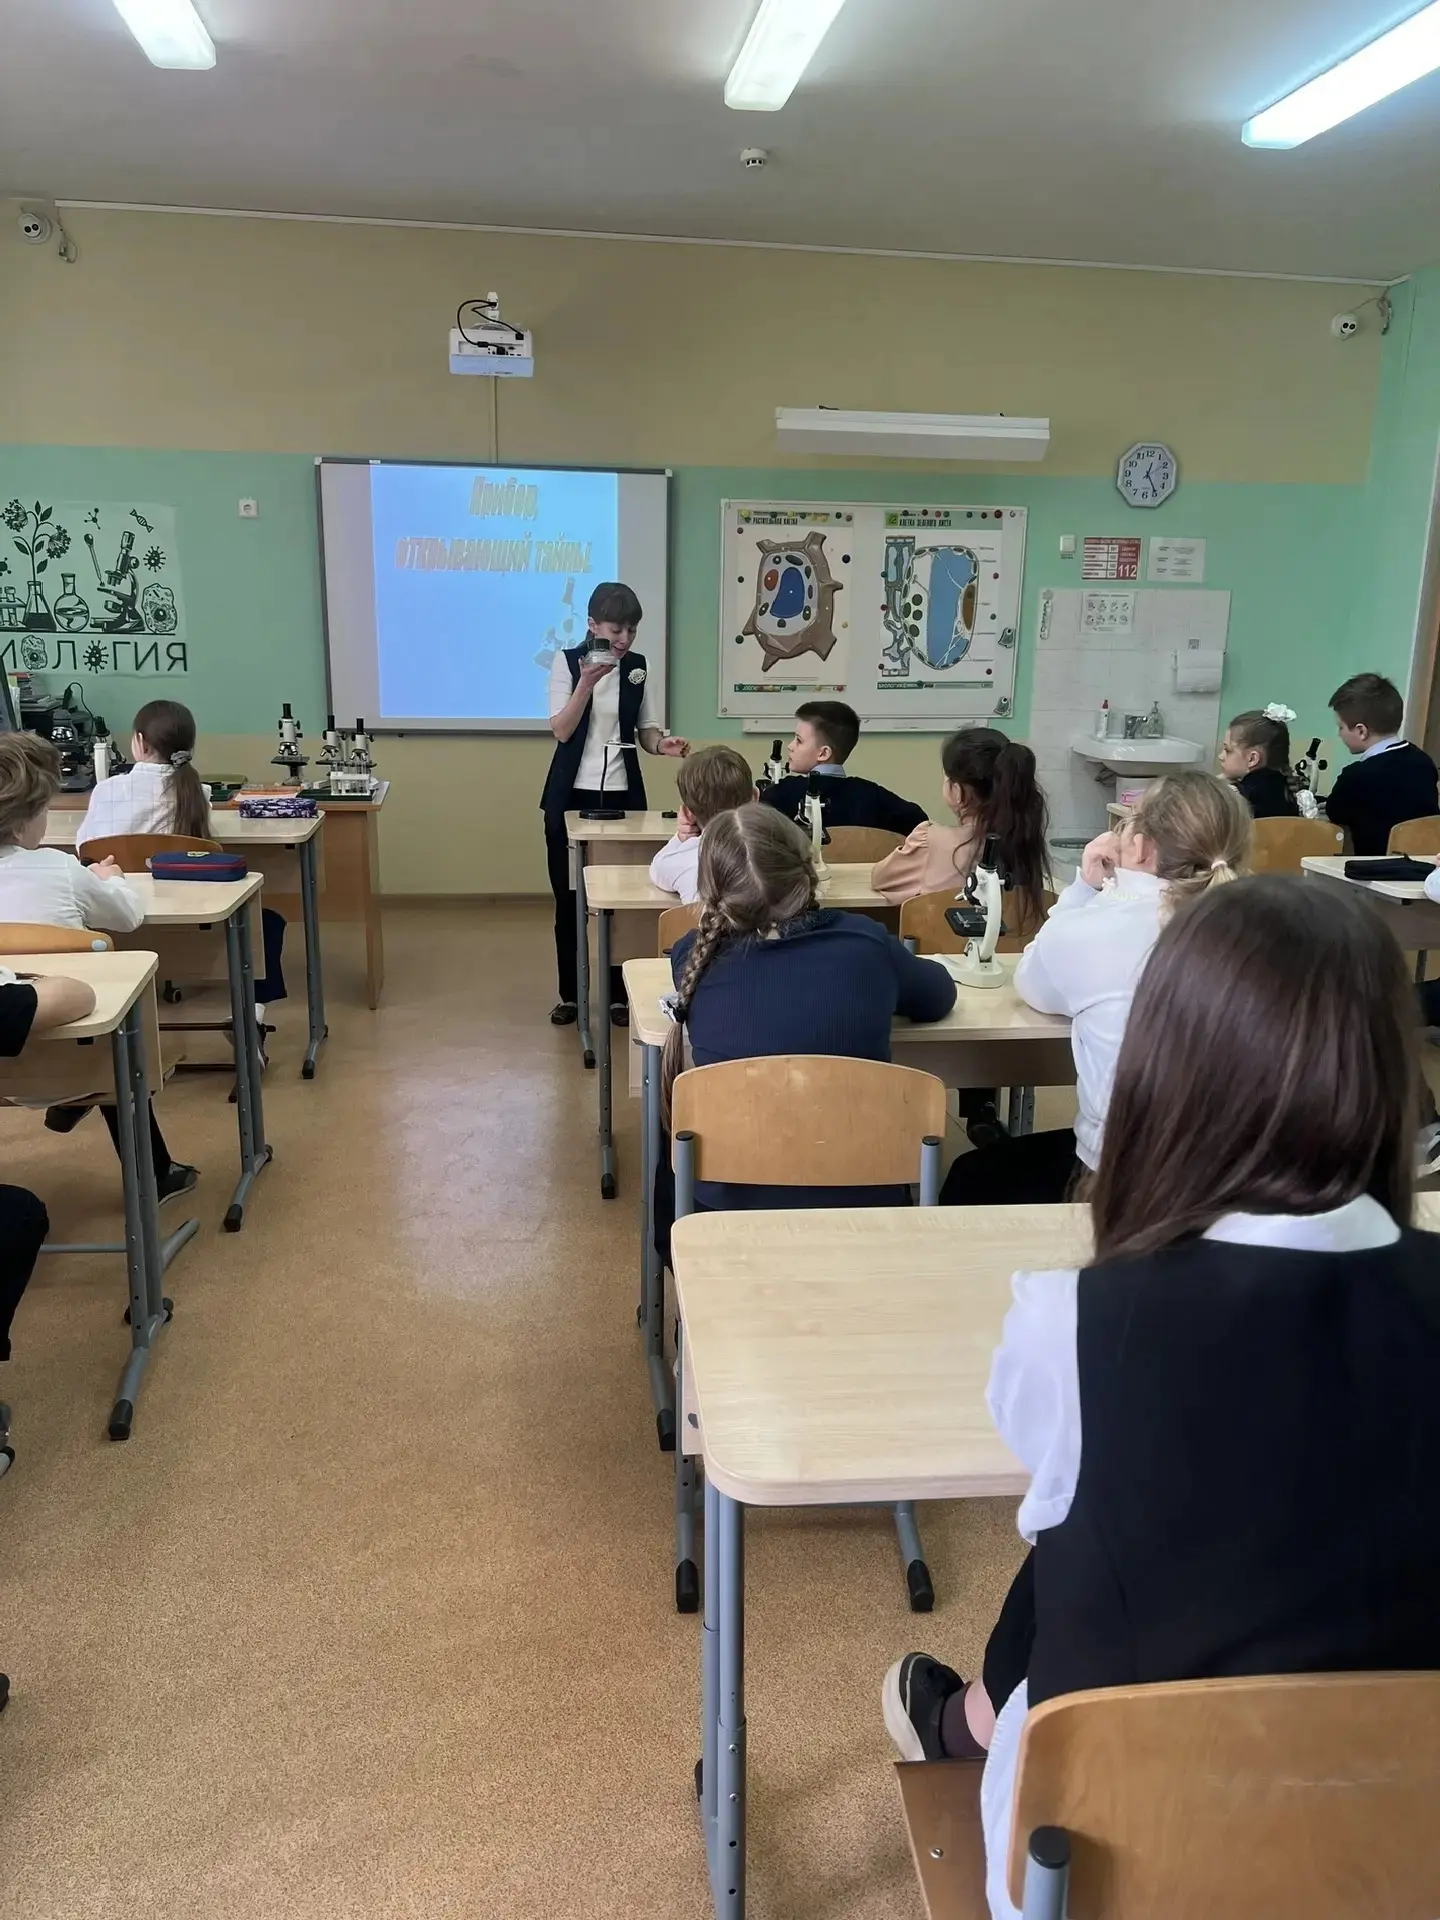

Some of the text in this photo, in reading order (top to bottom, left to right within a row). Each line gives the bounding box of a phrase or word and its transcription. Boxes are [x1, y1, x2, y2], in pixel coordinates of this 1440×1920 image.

[1136, 452, 1145, 460] 11
[1146, 450, 1156, 458] 12
[1158, 453, 1162, 461] 1
[1128, 460, 1138, 468] 10
[1162, 461, 1169, 469] 2
[1124, 469, 1132, 478] 9
[1162, 472, 1169, 480] 3
[1125, 479, 1132, 488] 8
[1160, 482, 1166, 490] 4
[1132, 488, 1139, 496] 7
[1141, 491, 1149, 500] 6
[1118, 564, 1137, 577] 112
